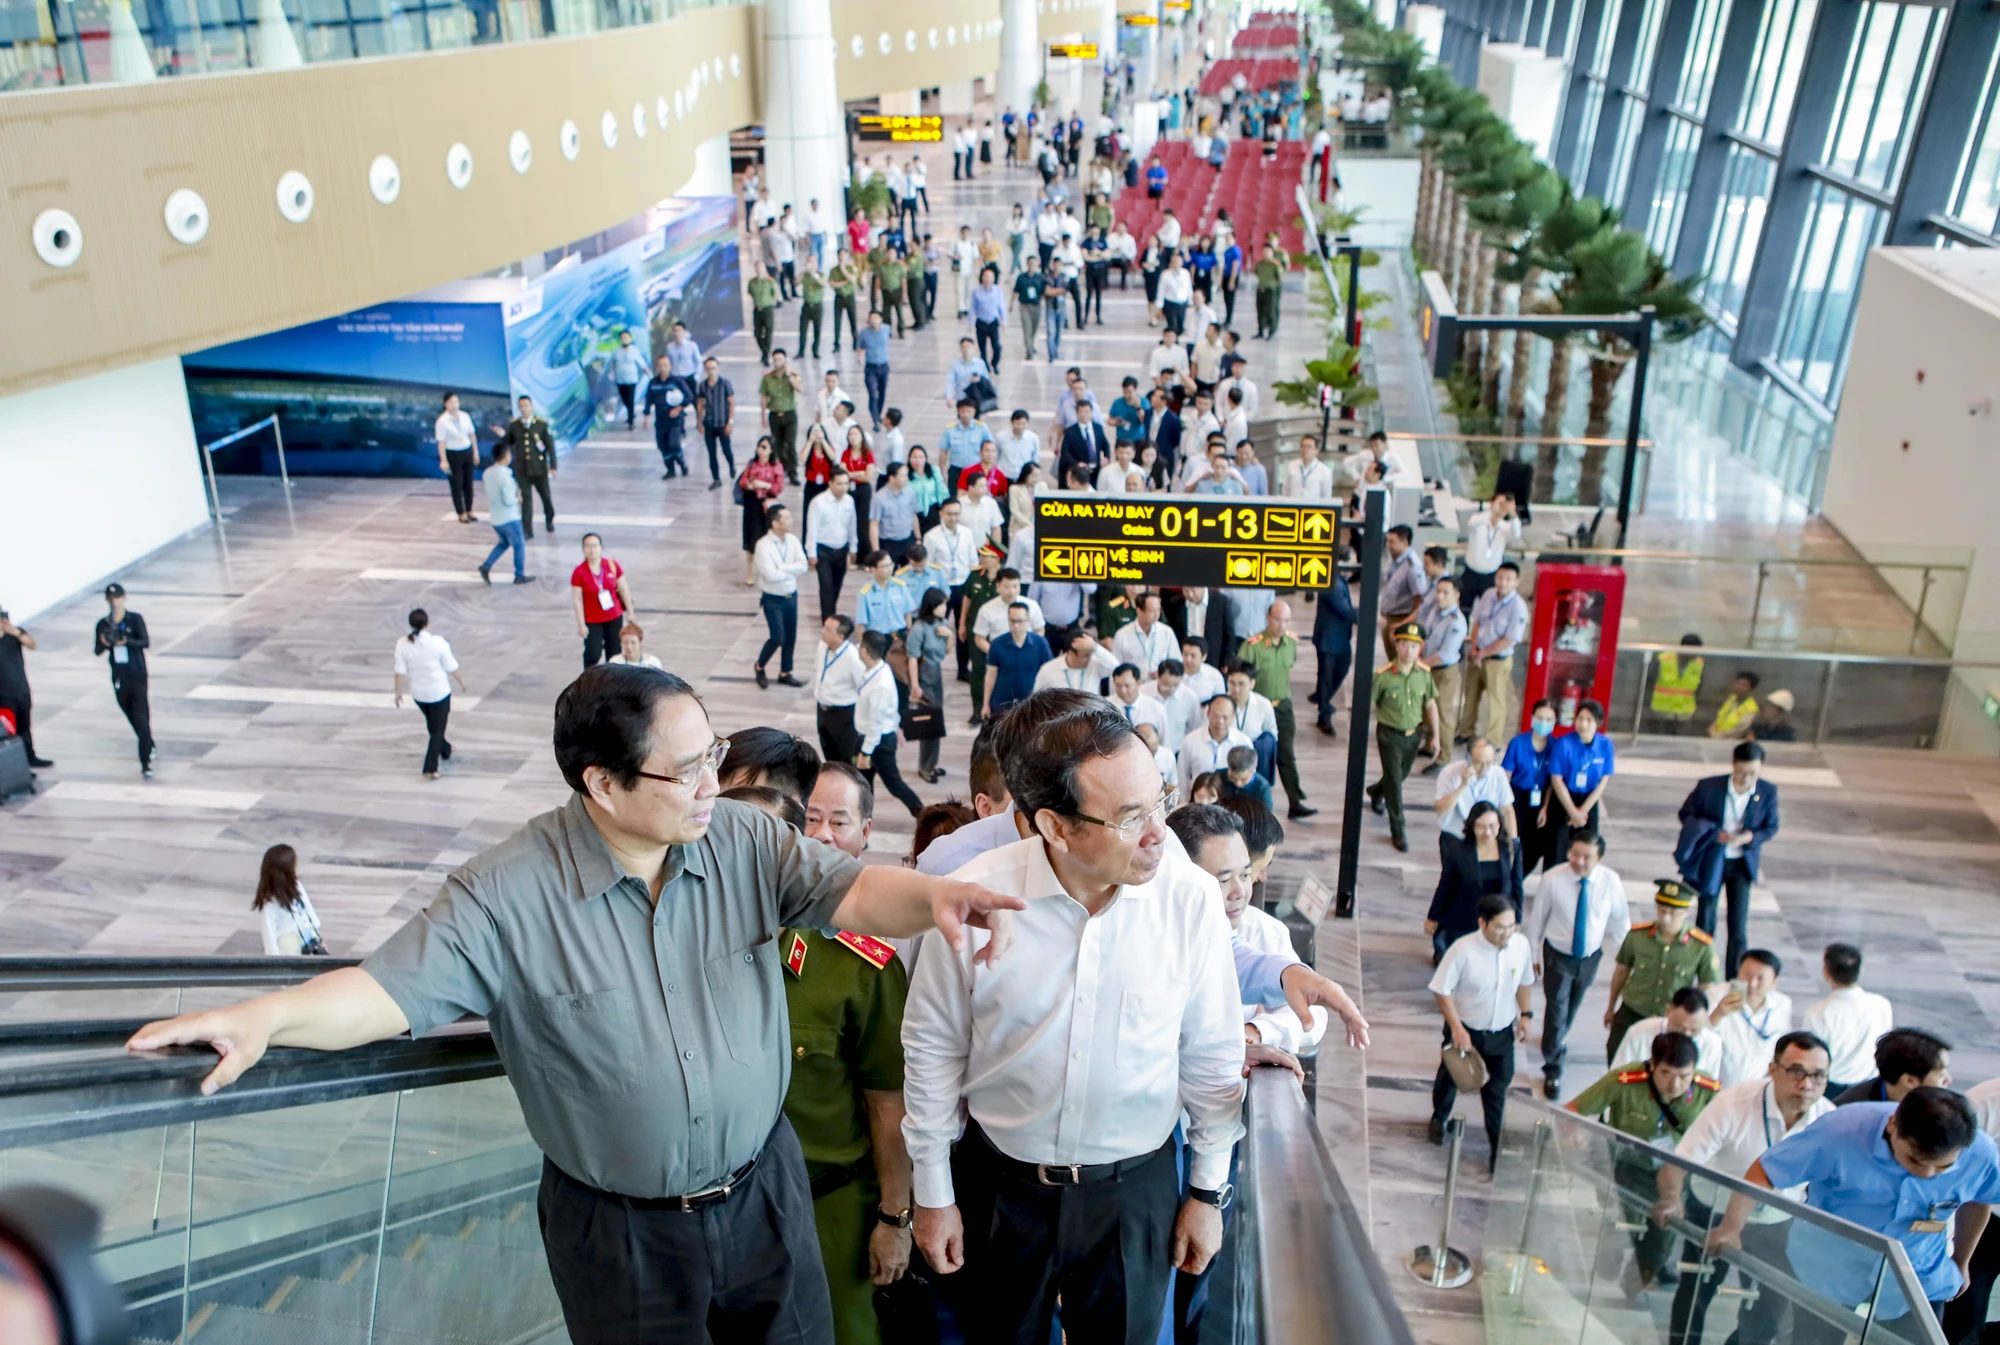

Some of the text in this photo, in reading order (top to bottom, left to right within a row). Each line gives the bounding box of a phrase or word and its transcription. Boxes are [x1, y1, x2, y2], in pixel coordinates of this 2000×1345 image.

[1040, 501, 1258, 540] CỬA RA TÀU BAY 01-13
[1109, 547, 1165, 565] VỆ SINH
